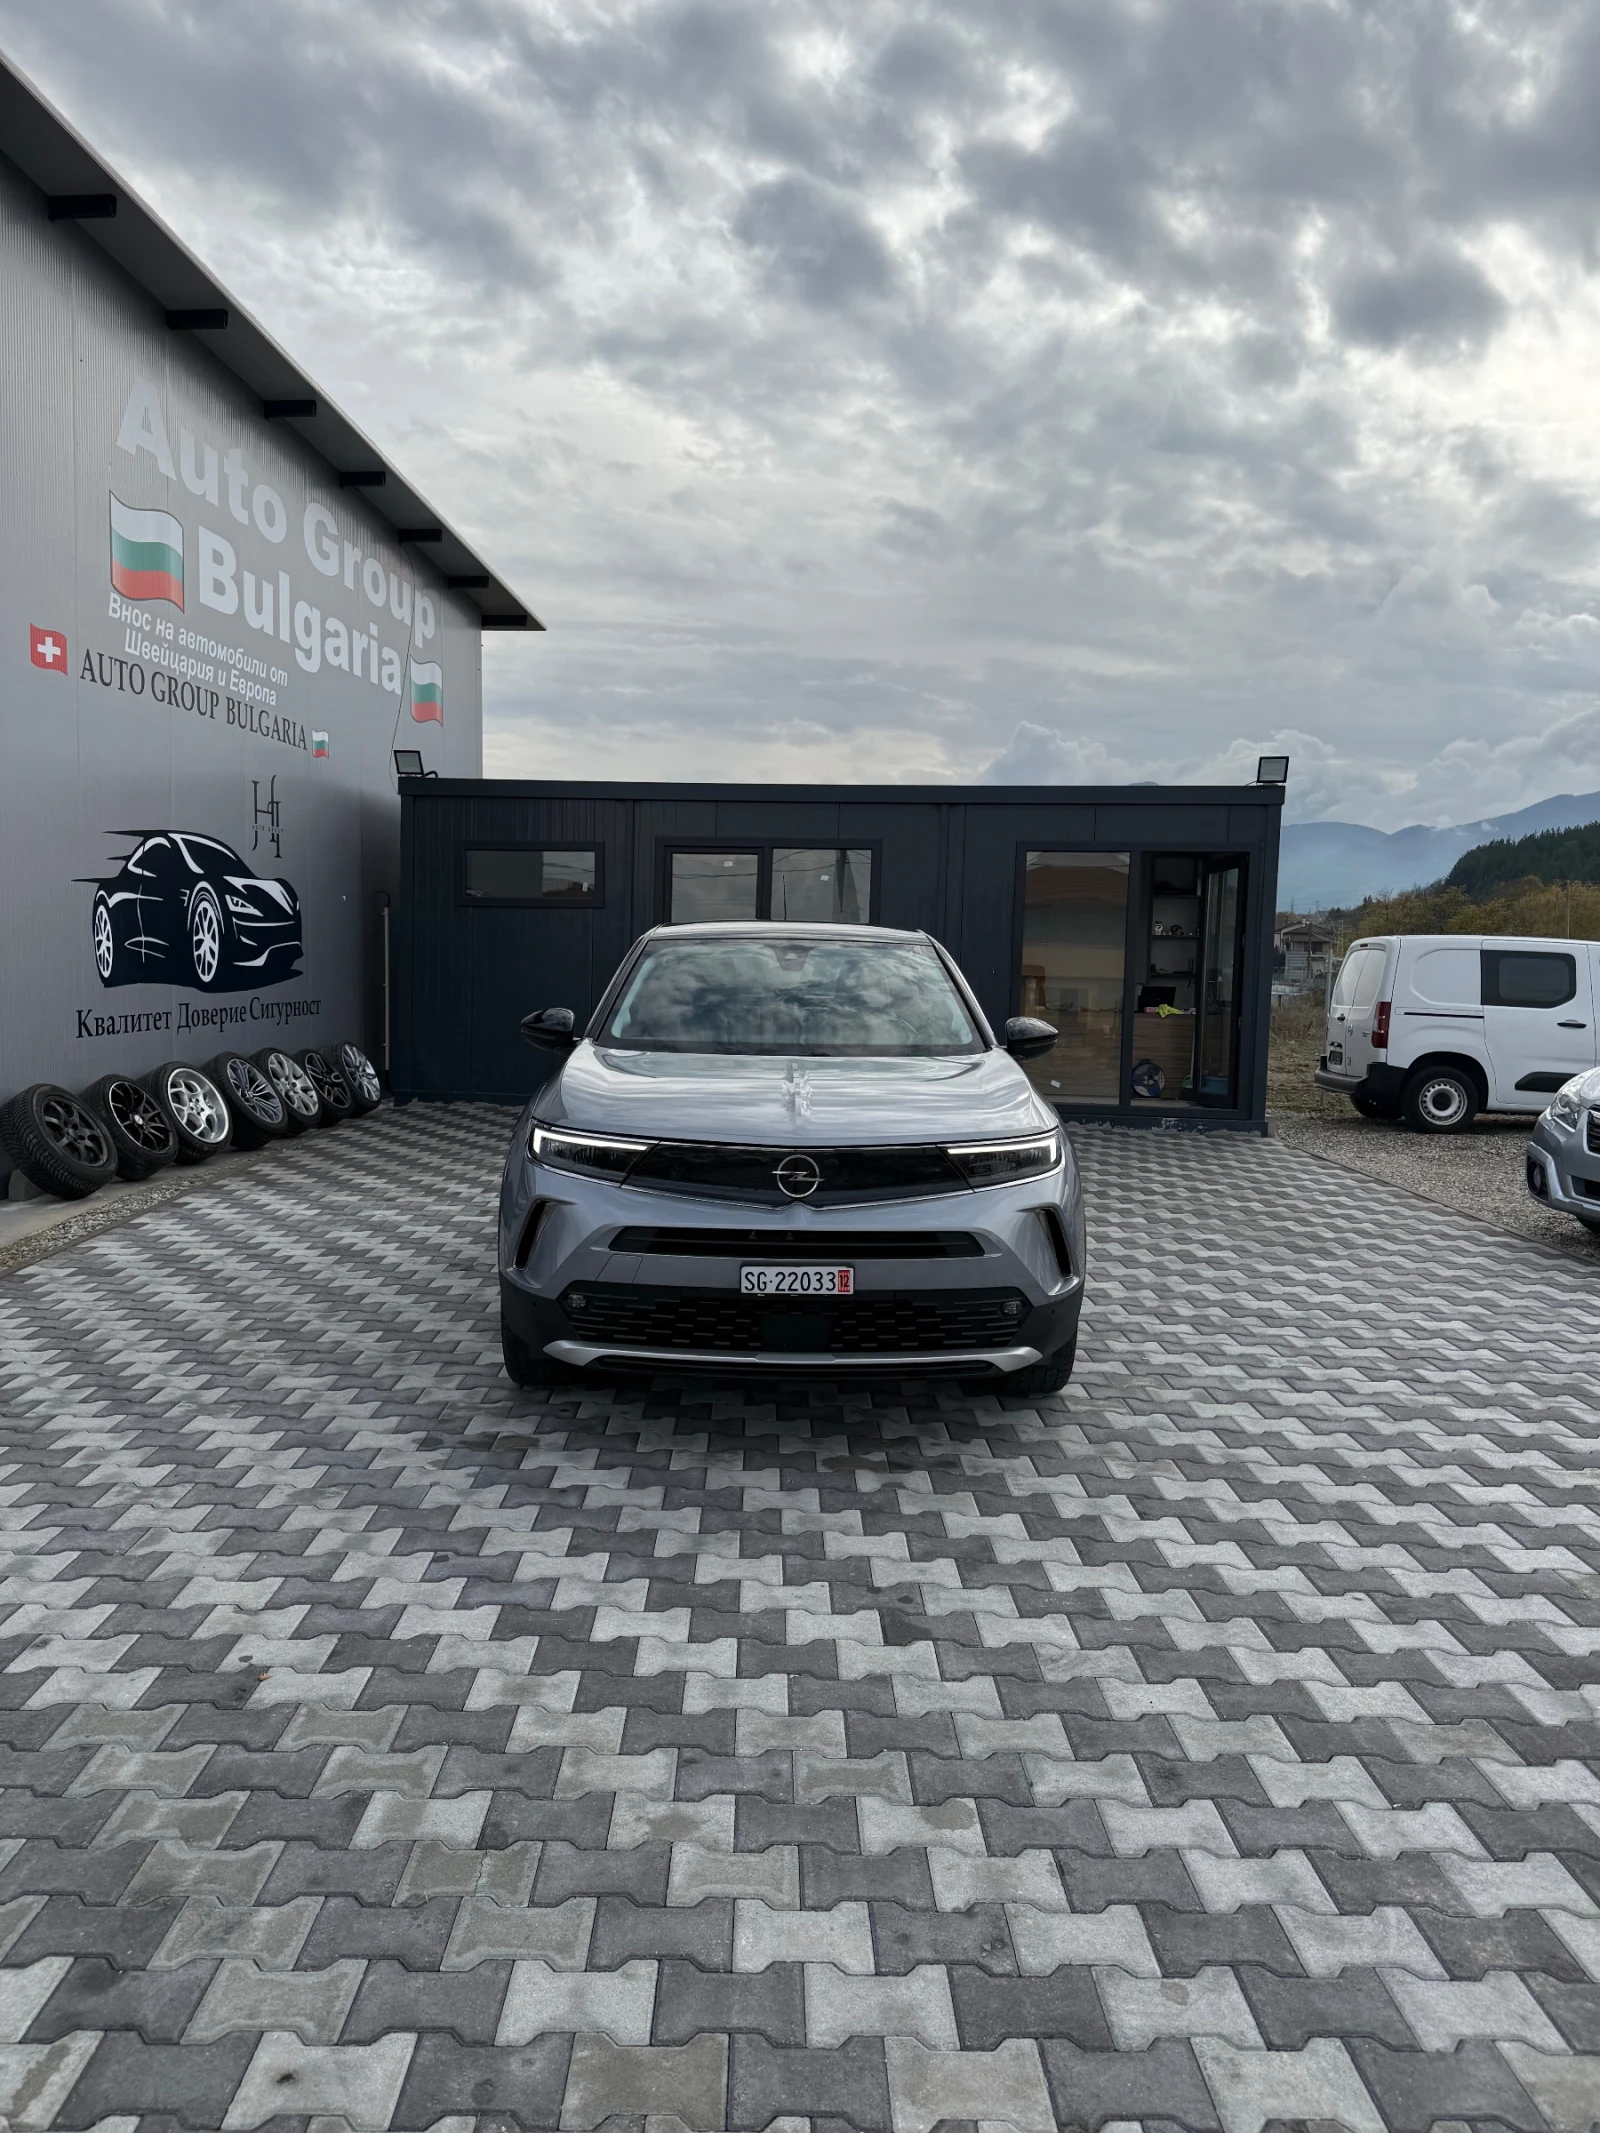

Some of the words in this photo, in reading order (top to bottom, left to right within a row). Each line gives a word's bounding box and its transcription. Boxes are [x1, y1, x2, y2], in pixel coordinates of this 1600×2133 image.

[116, 375, 287, 543] Auto
[303, 502, 435, 649] Group
[108, 592, 151, 631] Внос
[156, 618, 173, 640] на
[178, 627, 267, 678] автомобили
[270, 666, 288, 687] от
[199, 525, 402, 696] Bulgaria
[80, 648, 145, 695] AUTO
[151, 671, 220, 720] GROUP
[225, 696, 308, 750] BULGARIA
[125, 628, 213, 681] Швейцария
[218, 669, 226, 686] и
[230, 669, 277, 706] Европа
[76, 1009, 172, 1038] Квалитет
[177, 1002, 247, 1035] Доверие
[249, 996, 322, 1026] Сигурност
